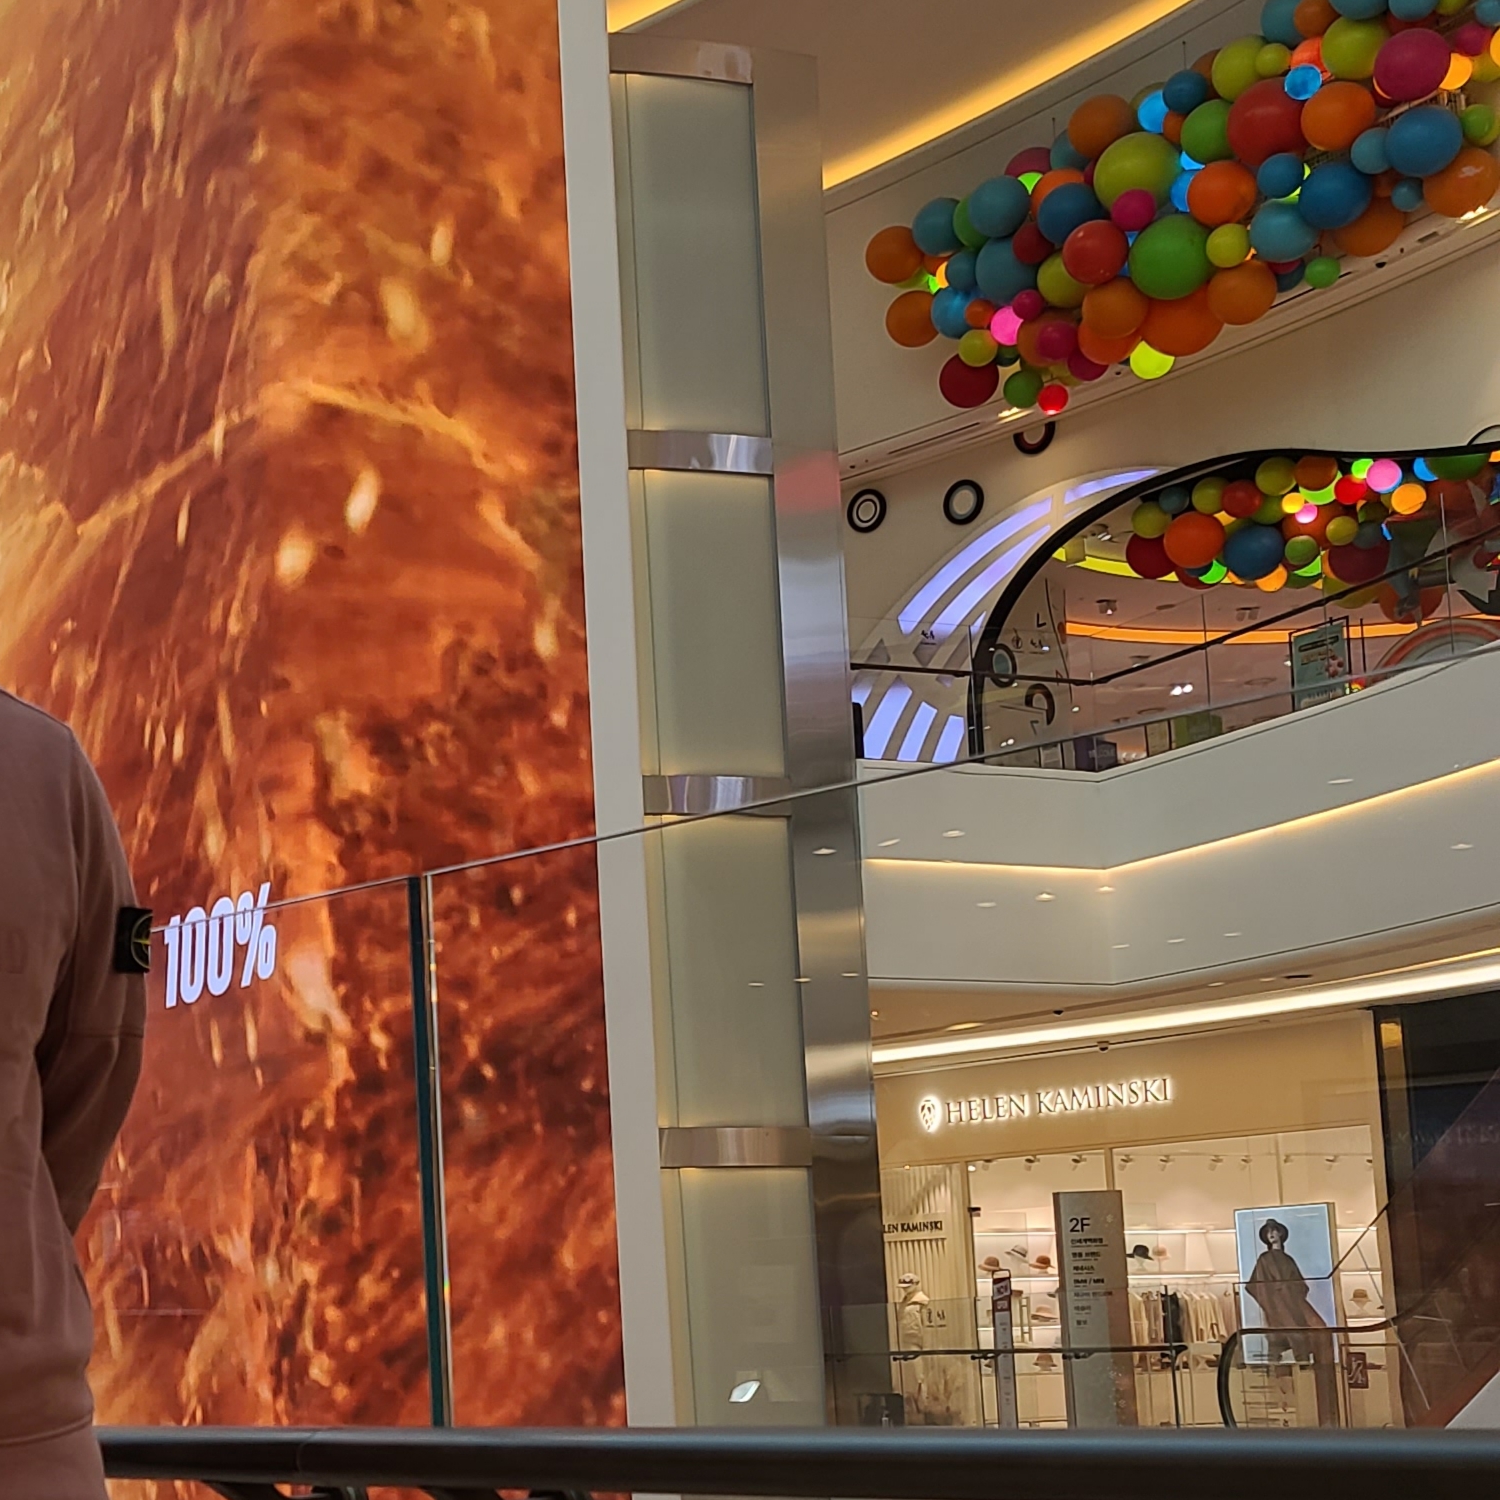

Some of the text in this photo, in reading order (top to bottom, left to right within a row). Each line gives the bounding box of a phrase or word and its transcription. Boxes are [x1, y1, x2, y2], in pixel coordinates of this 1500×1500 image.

[164, 881, 277, 1009] 100%
[945, 1078, 1172, 1124] HELEN KAMINSKI
[882, 1220, 943, 1234] LEN KAMINSKI
[1069, 1217, 1091, 1232] 2F
